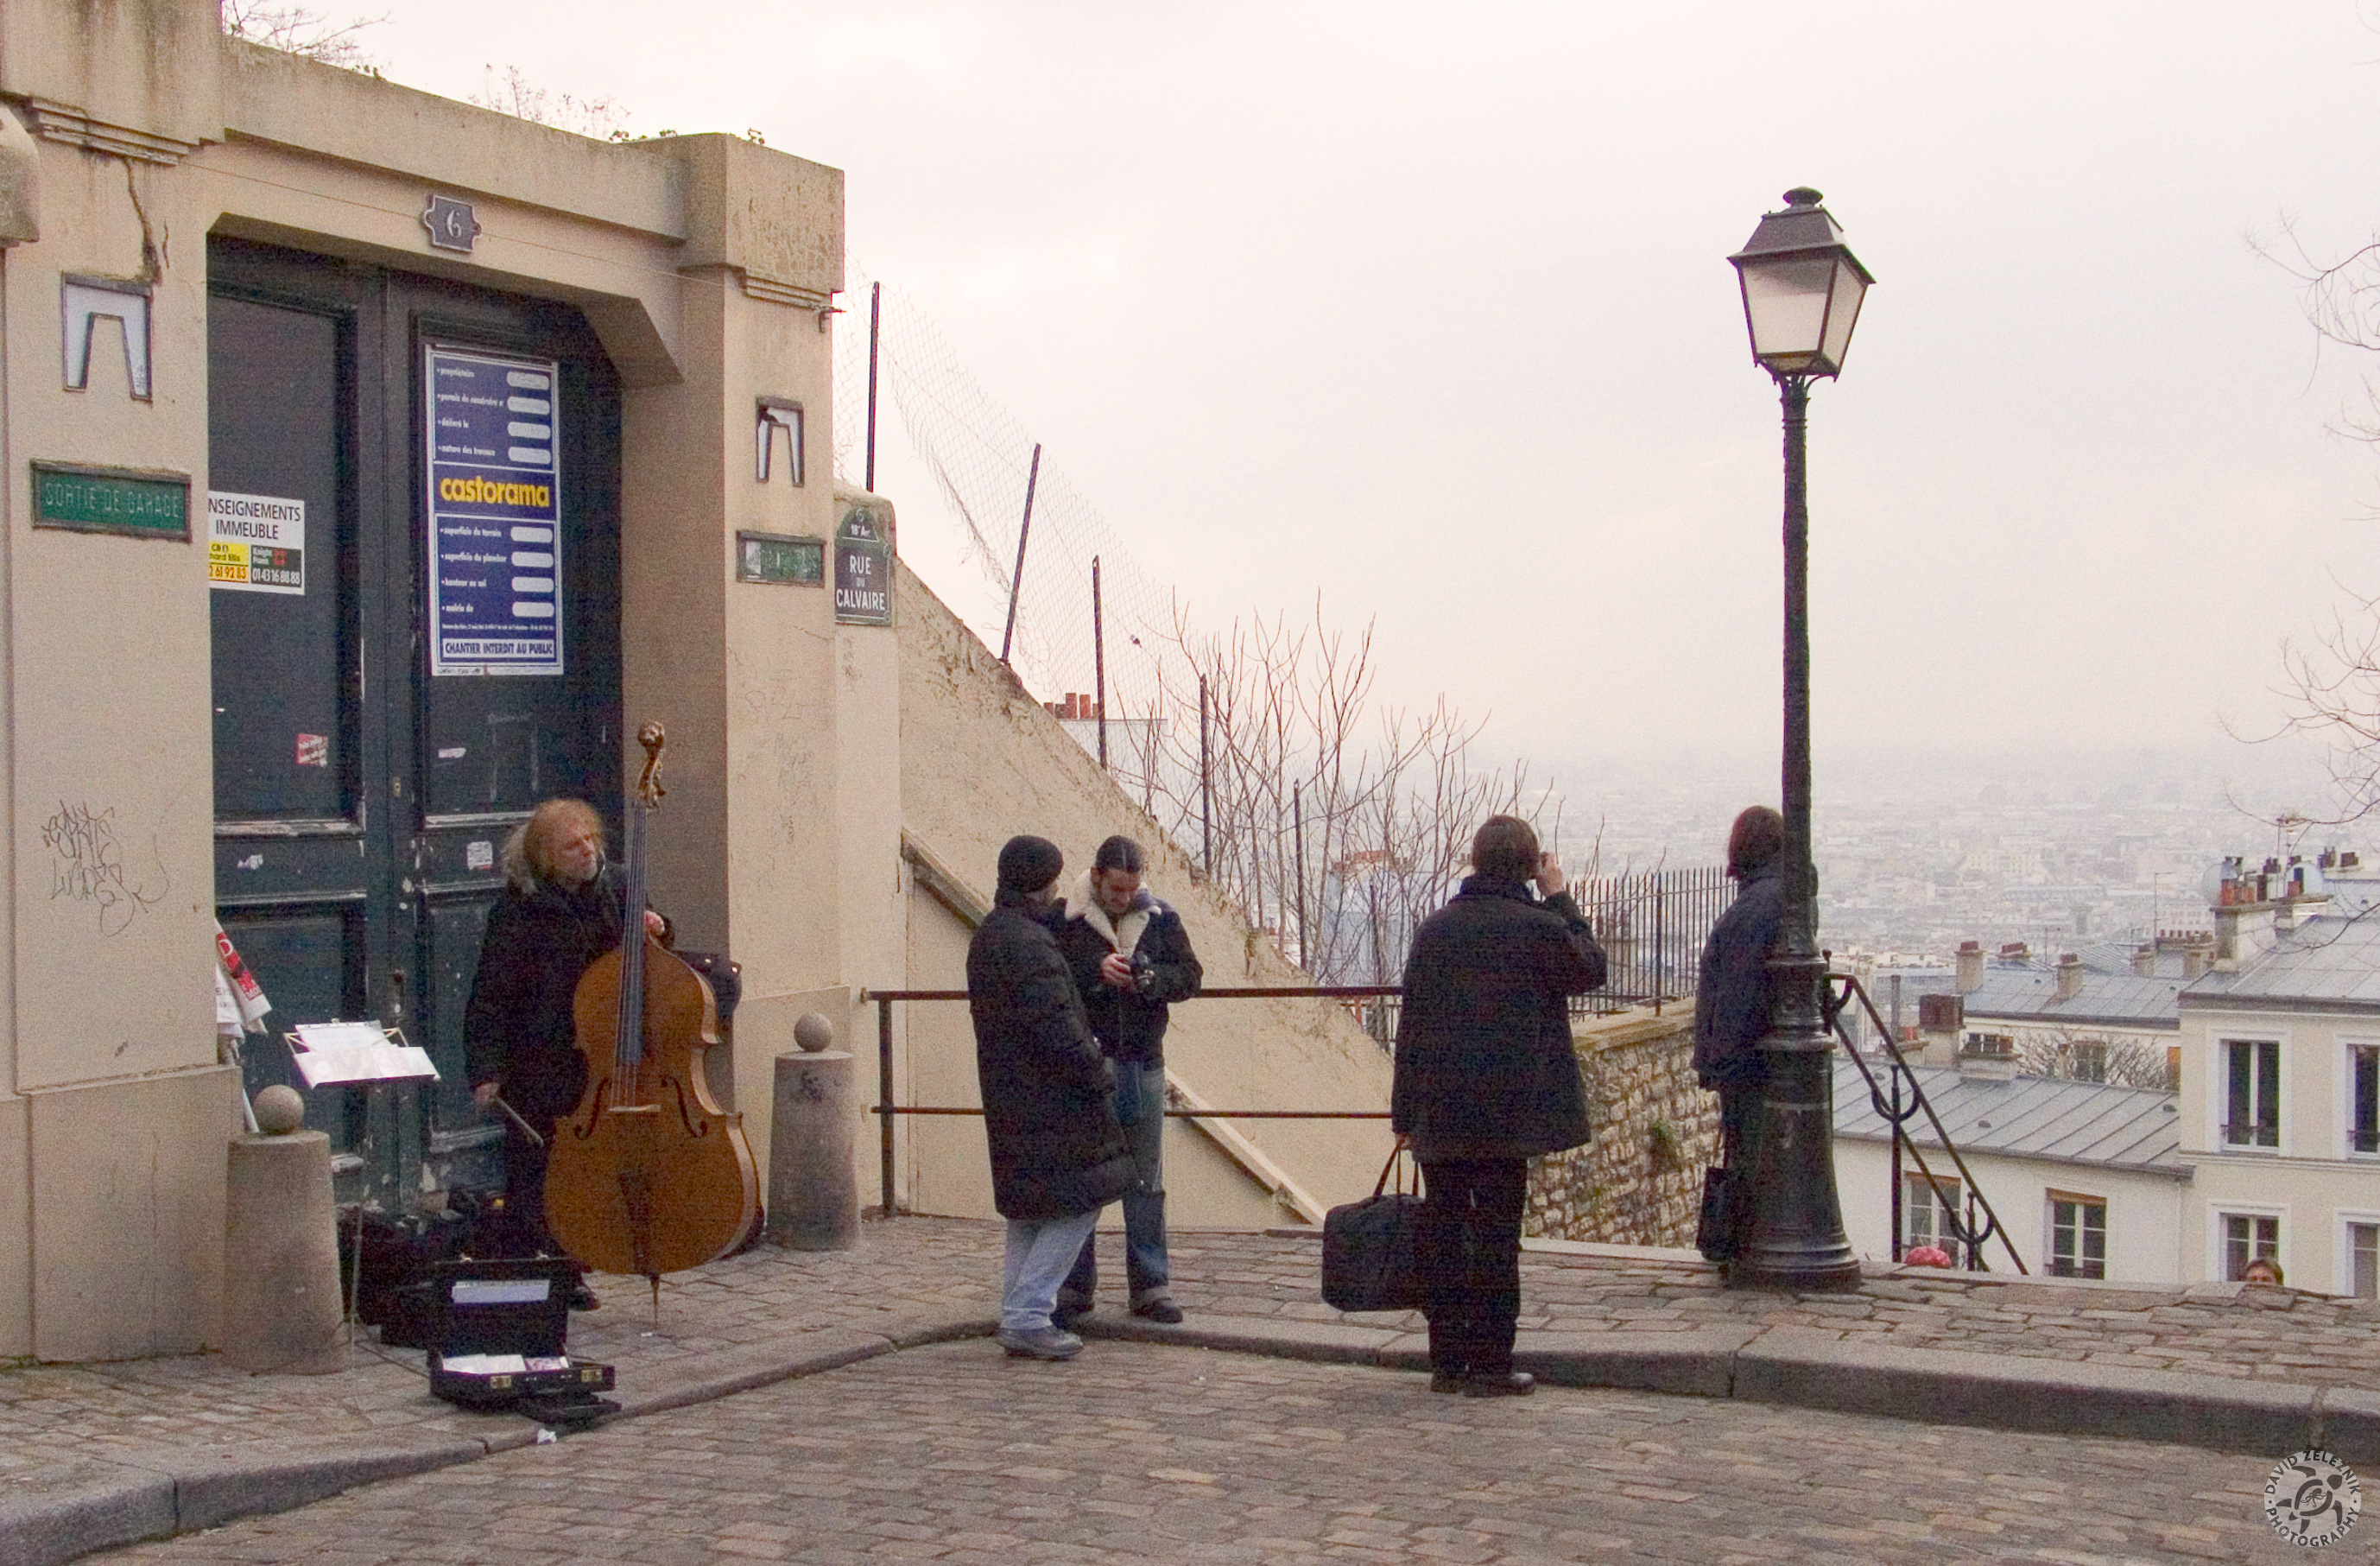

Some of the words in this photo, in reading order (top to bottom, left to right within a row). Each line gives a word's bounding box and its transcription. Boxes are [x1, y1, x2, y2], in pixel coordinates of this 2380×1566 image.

[446, 210, 462, 238] 6
[45, 482, 96, 510] SORTIE
[104, 489, 120, 511] DE
[128, 491, 179, 518] GARAGE
[440, 476, 550, 508] castorama
[216, 520, 278, 540] IMMEUBLE
[850, 555, 871, 575] RUE
[857, 577, 865, 587] DU
[836, 589, 886, 612] CALVAIRE
[446, 642, 481, 654] CHANTIER
[483, 642, 515, 655] INTERDIT
[516, 643, 527, 655] AU
[529, 643, 553, 655] PUBLIC
